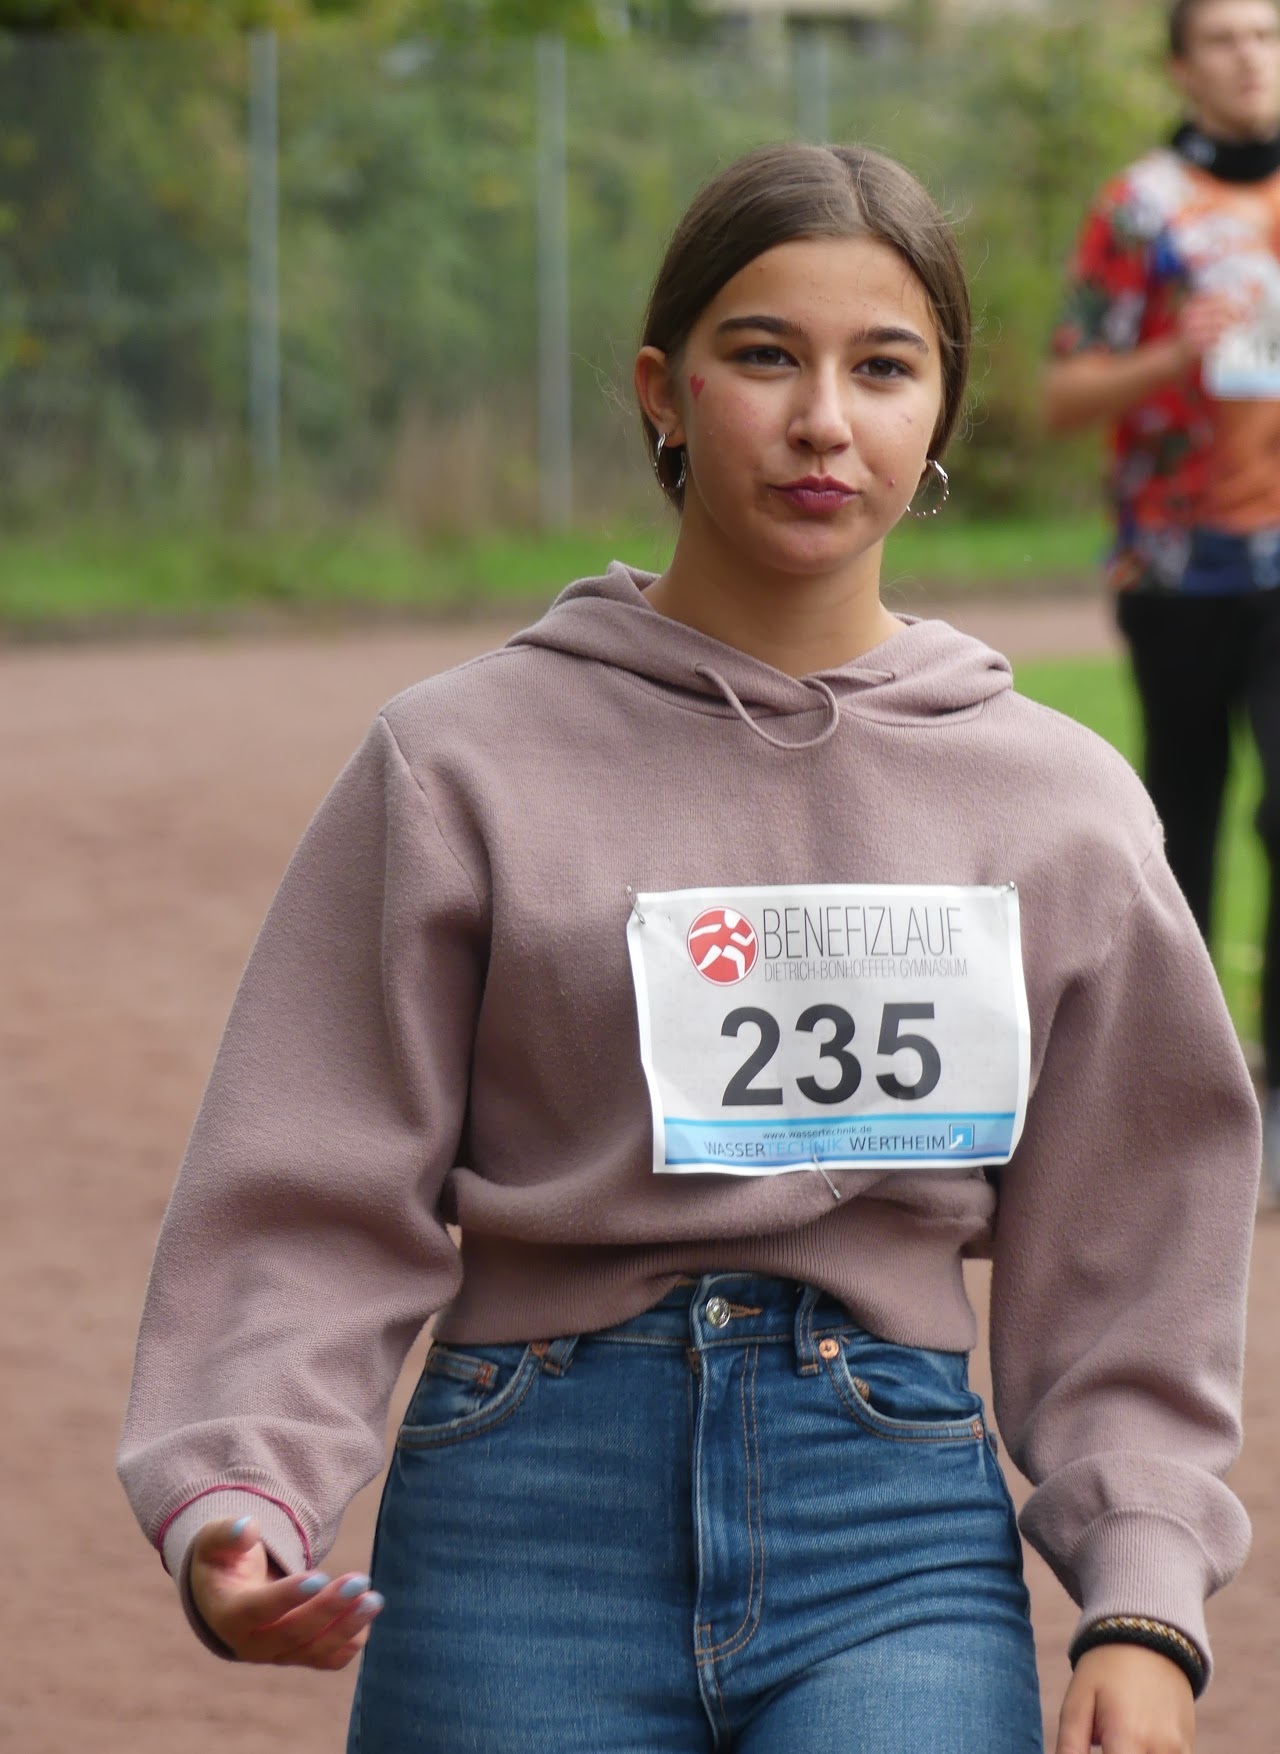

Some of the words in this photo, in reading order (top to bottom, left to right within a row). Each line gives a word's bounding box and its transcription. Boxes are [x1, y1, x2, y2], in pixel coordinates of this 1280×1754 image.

[763, 906, 963, 959] BENEFIZLAUF
[899, 958, 968, 979] GYMNASIUM
[720, 1001, 942, 1106] 235
[762, 1124, 872, 1140] www.wassertechnik.de
[704, 1136, 843, 1158] WASSERTECHNIK
[849, 1134, 945, 1151] WERTHEIM
